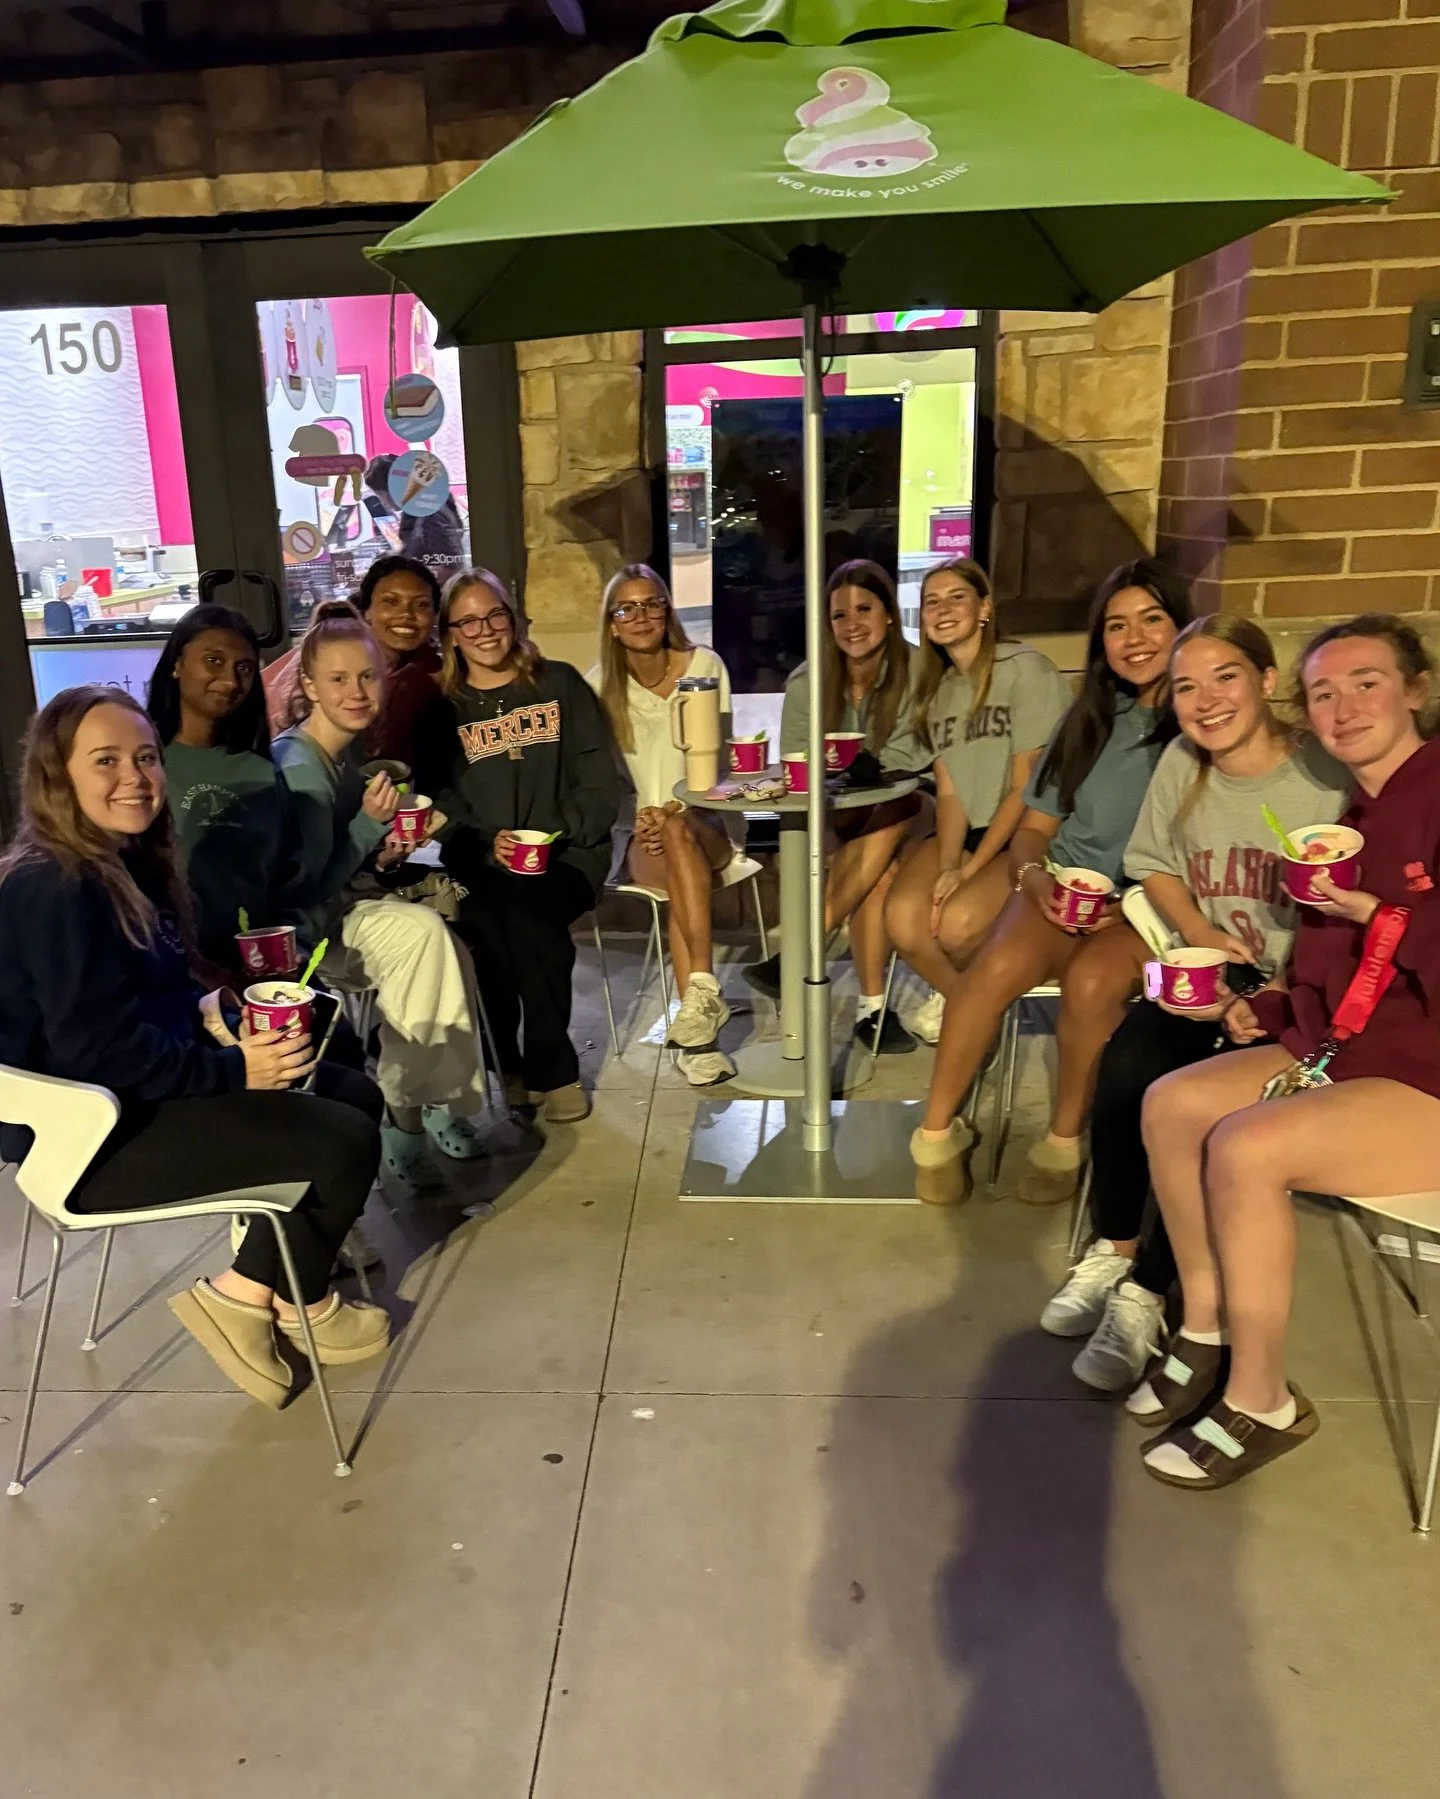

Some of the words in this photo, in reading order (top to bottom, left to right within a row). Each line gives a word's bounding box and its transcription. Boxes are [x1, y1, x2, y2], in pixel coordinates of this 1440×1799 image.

[777, 175, 806, 190] we
[809, 185, 873, 199] make
[878, 184, 920, 199] you
[921, 166, 967, 189] smile
[30, 319, 122, 375] 150
[336, 571, 362, 582] fri-sa
[458, 702, 560, 757] MERCER
